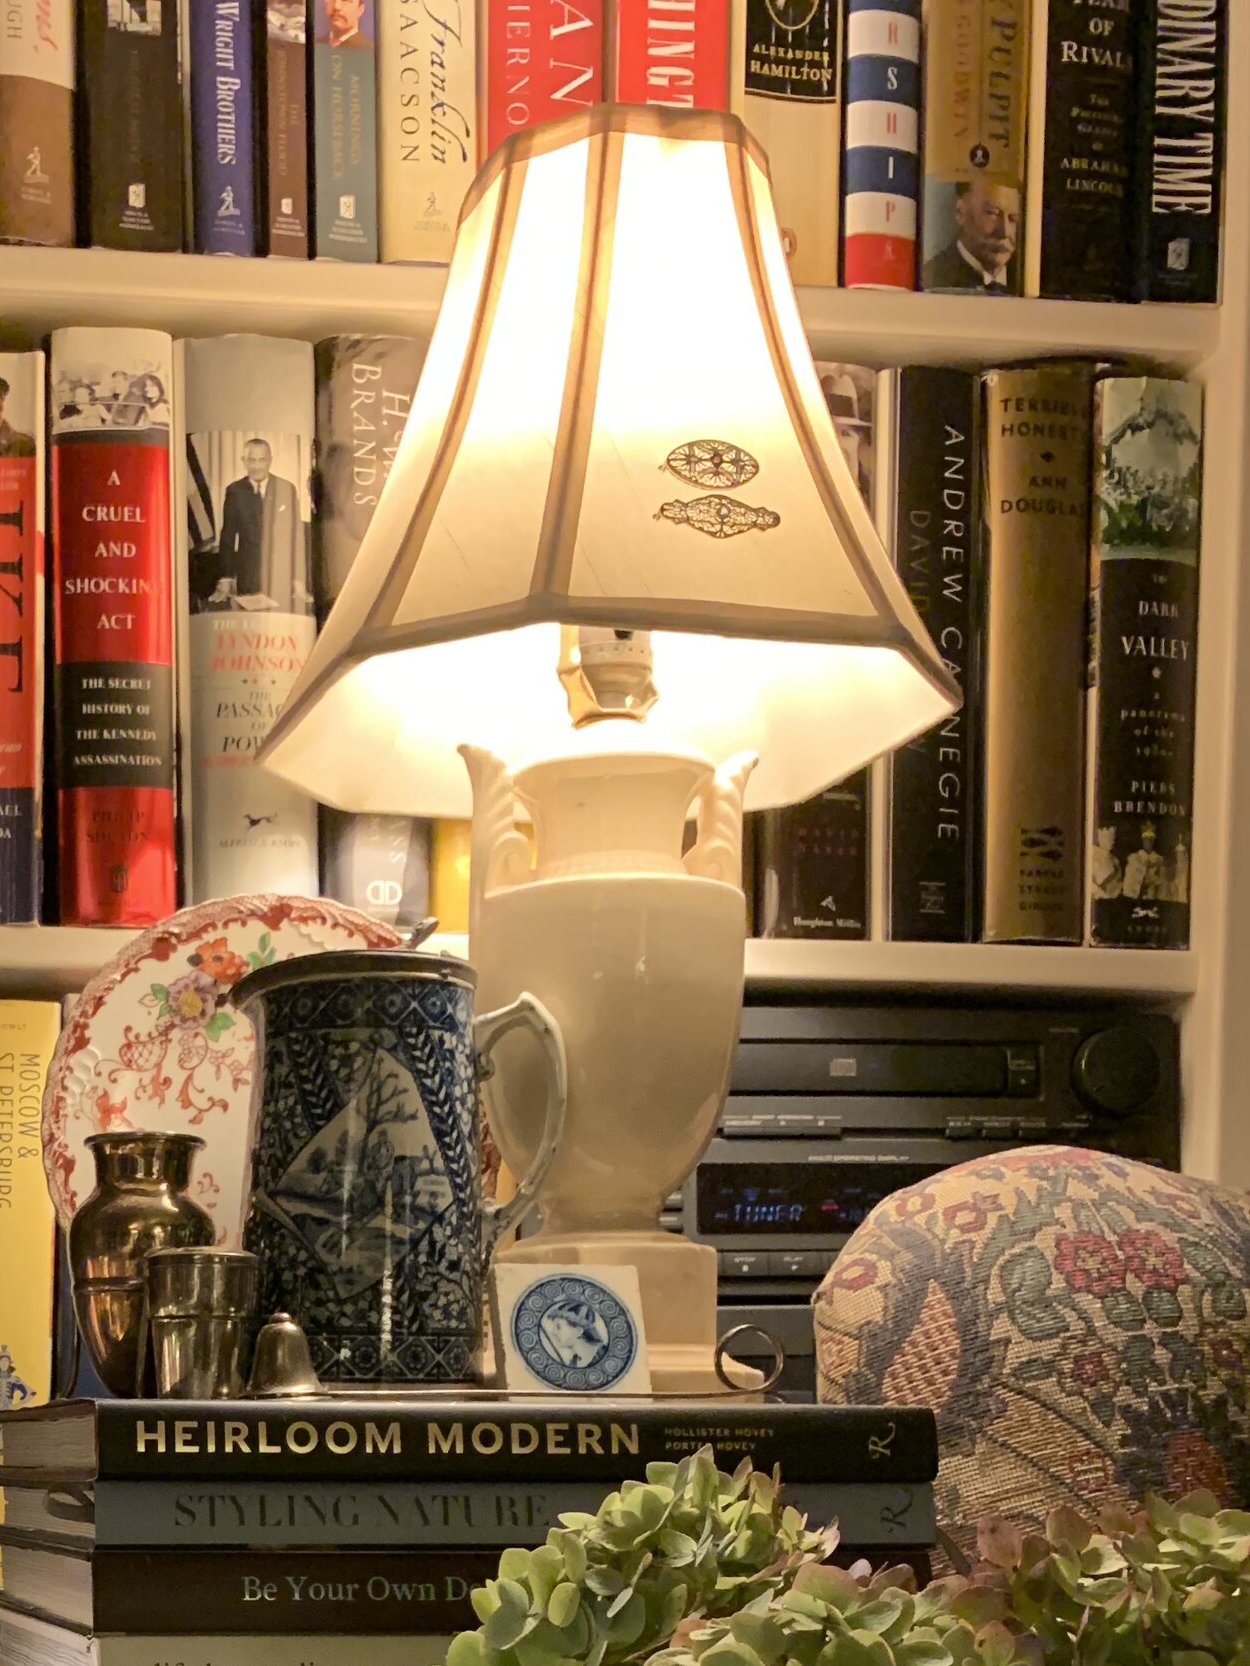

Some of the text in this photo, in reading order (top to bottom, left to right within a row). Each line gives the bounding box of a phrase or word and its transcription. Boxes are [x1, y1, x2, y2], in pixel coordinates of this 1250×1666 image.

[1088, 17, 1115, 37] OF
[752, 42, 830, 62] ALEXANDER
[750, 60, 833, 83] HAMILTON
[215, 75, 241, 166] BROTHERS
[1151, 131, 1214, 216] TIME
[350, 362, 383, 507] BRANDS
[106, 470, 121, 486] A
[81, 505, 147, 524] CRUEL
[94, 541, 137, 559] AND
[96, 612, 136, 631] ACT
[937, 424, 966, 843] ANDREW CANEGIE
[1119, 635, 1191, 661] VALLEY
[81, 676, 152, 691] THE SECRET
[81, 702, 134, 716] HISTORY
[76, 727, 158, 742] THE KENNEDY
[72, 753, 163, 768] ASSASSINATION
[17, 1052, 41, 1159] MOSCOW &
[134, 1419, 641, 1457] HEIRLOOM MODERN
[664, 1427, 775, 1438] HOLLISTER HOVEY
[716, 1441, 757, 1451] HOVEY
[173, 1494, 552, 1528] STYLING NATURE
[241, 1575, 436, 1602] Be Your Own
